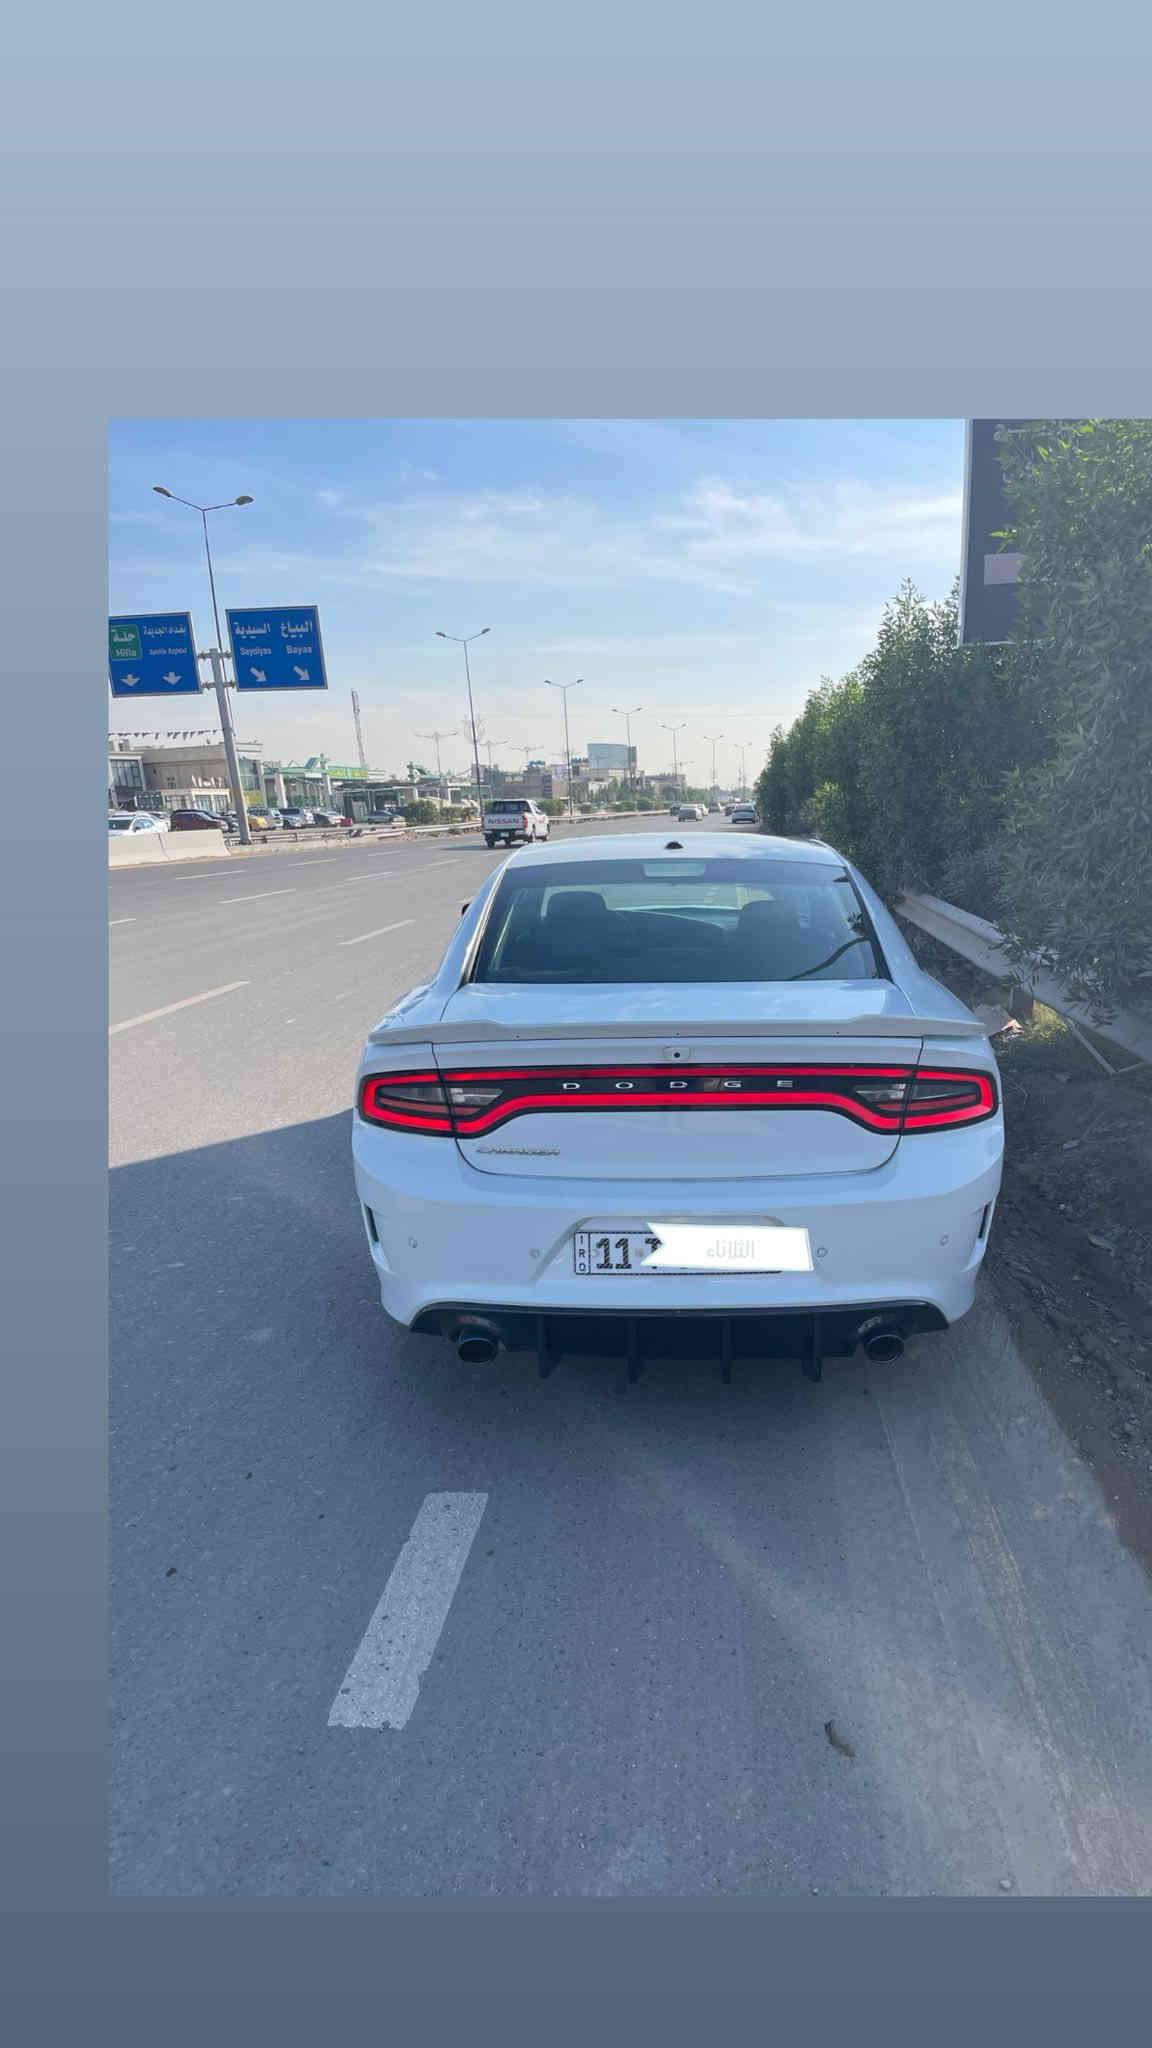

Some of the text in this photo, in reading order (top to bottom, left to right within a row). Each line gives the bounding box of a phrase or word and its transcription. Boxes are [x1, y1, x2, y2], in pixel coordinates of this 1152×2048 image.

[233, 622, 271, 639] السيدية
[562, 1079, 794, 1090] DODGE
[596, 1238, 632, 1269] 11
